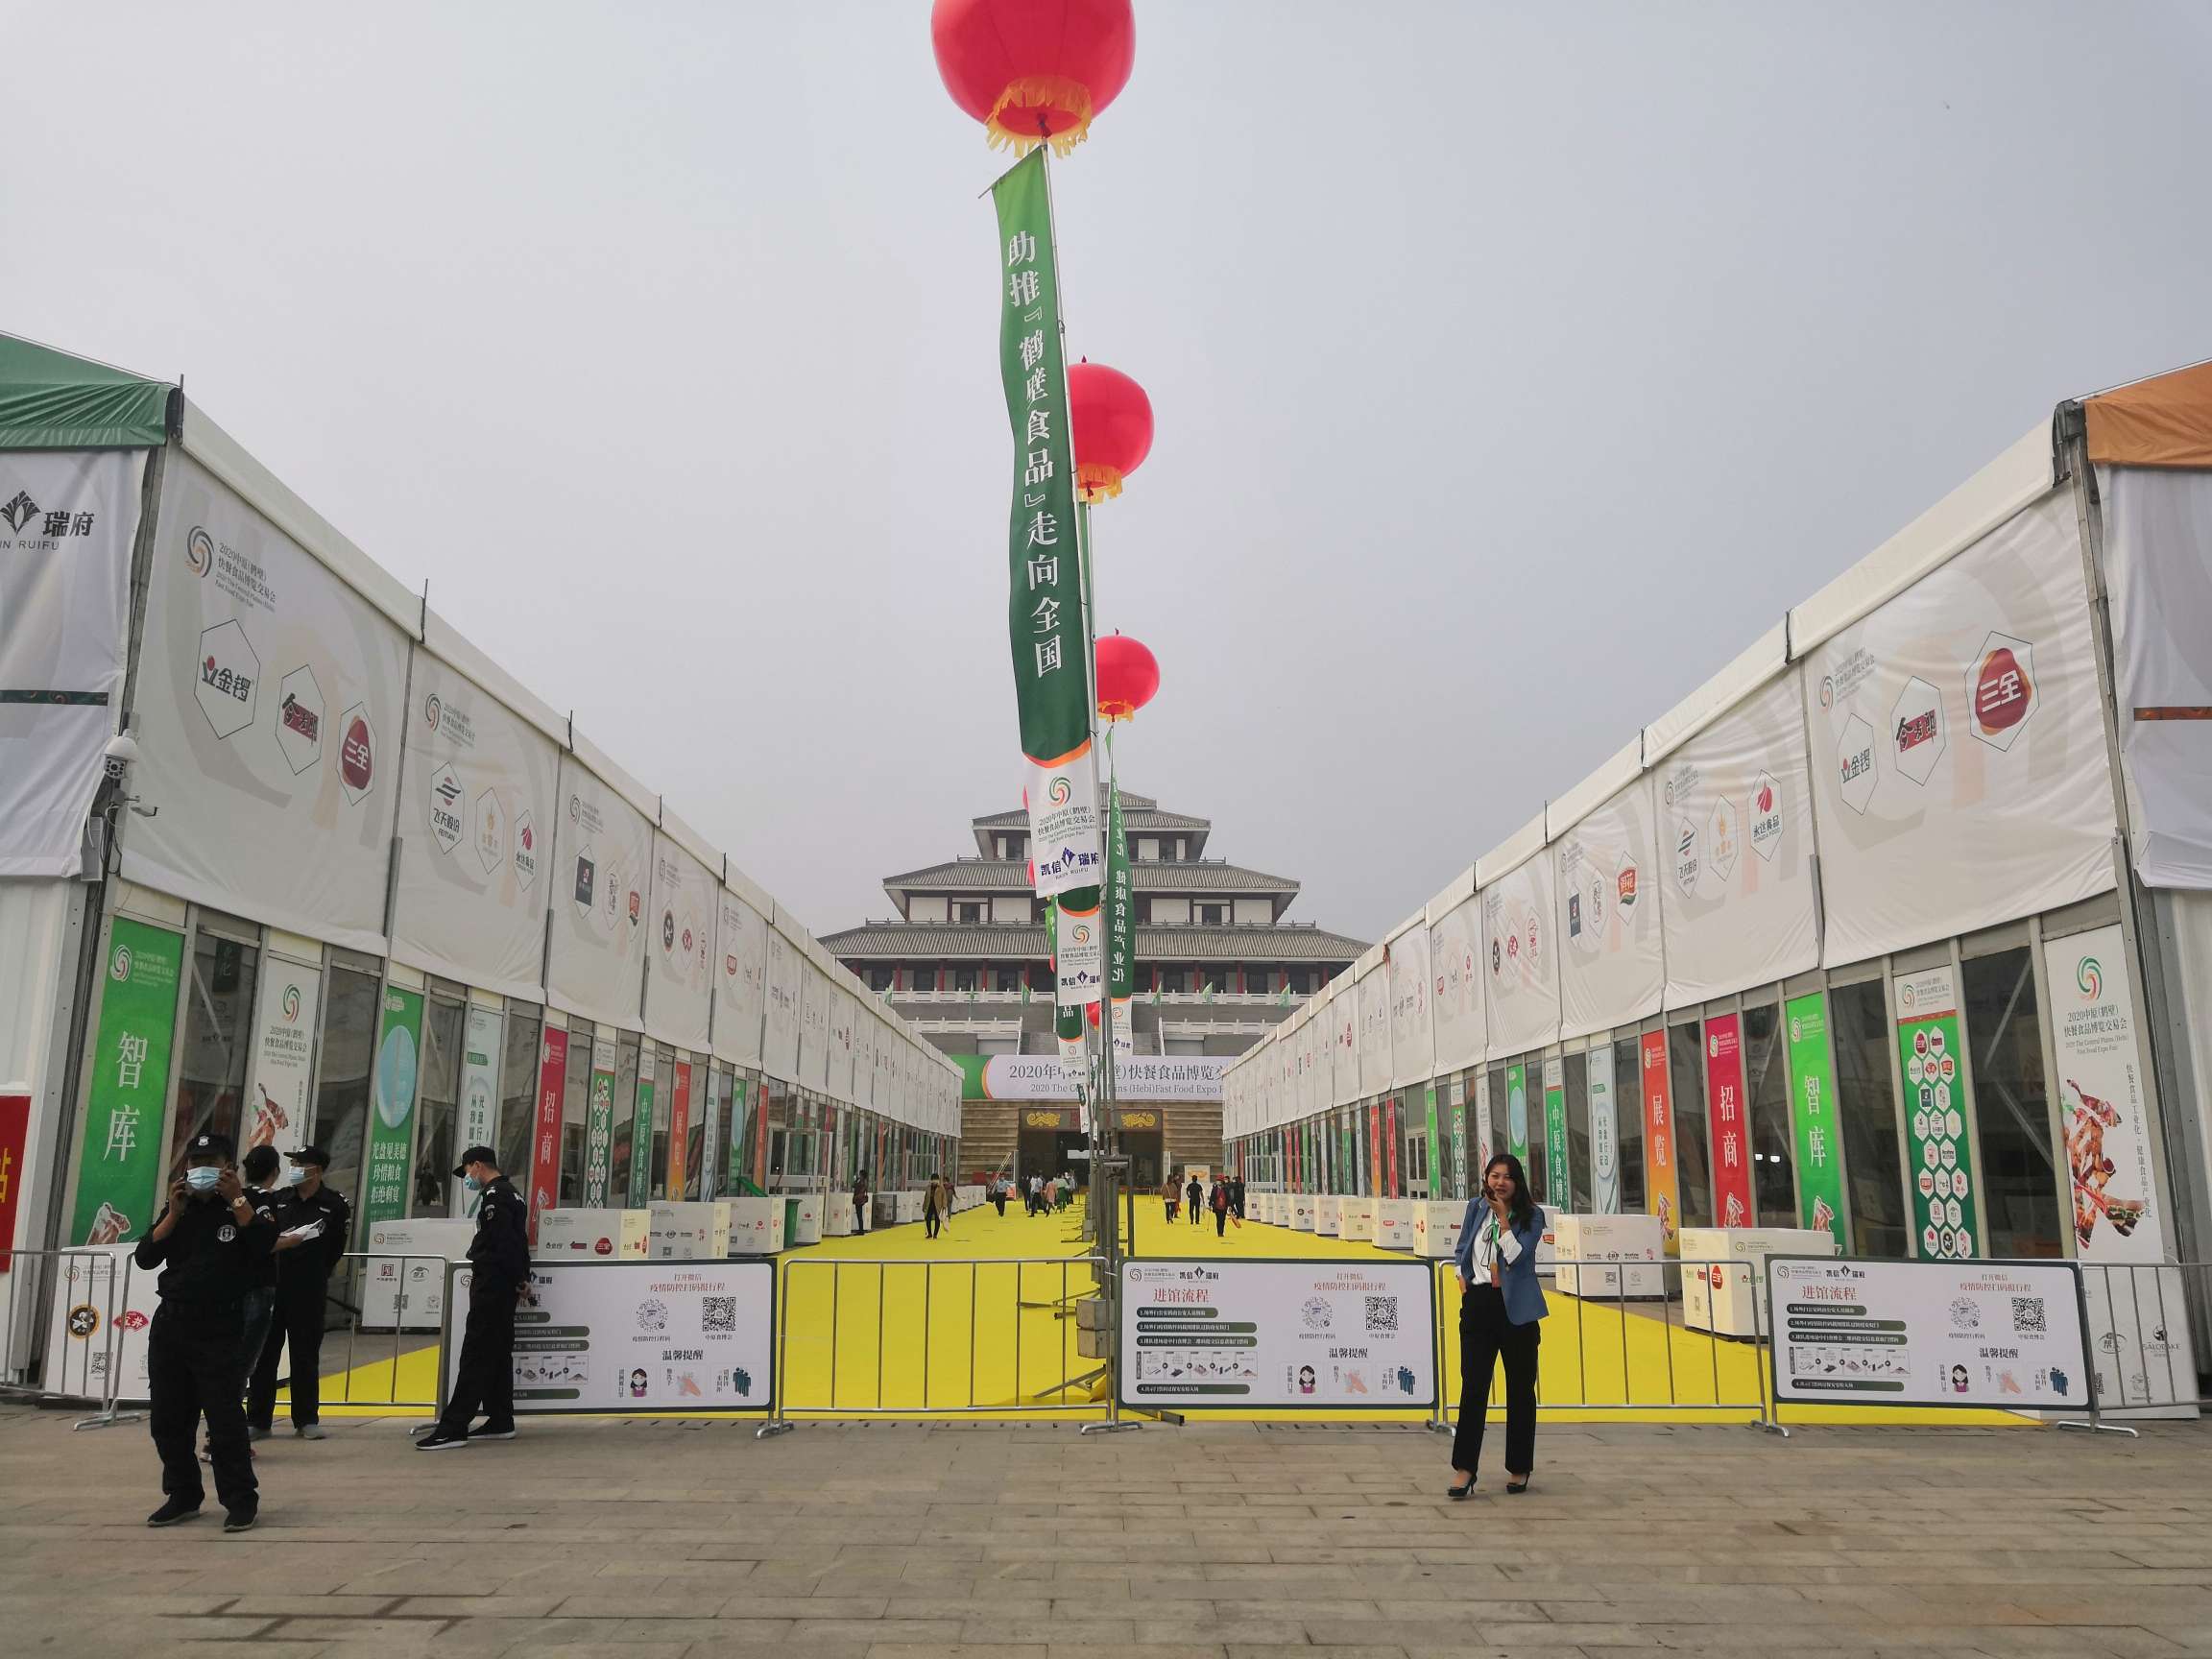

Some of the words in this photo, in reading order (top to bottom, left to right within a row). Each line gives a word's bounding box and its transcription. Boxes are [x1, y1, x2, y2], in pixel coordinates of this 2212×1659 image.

[42, 510, 95, 538] 瑞府
[18, 540, 60, 551] RUIFU
[1980, 669, 2022, 713] 三全
[345, 736, 369, 771] 三全
[1040, 860, 1062, 877] 凯信
[103, 1030, 148, 1162] 智库
[1052, 1083, 1068, 1093] The
[1173, 1084, 1195, 1094] Food
[1196, 1084, 1218, 1095] Expo
[541, 1090, 556, 1166] 招商
[1652, 1094, 1667, 1167] 展览
[1719, 1085, 1739, 1168] 招商
[1804, 1074, 1827, 1168] 智库
[1152, 1288, 1210, 1303] 进馆流程
[1802, 1286, 1858, 1301] 进馆流程
[661, 1349, 704, 1361] 温馨提醒
[1329, 1347, 1368, 1358] 温馨提醒
[1980, 1347, 2019, 1358] 温馨提醒
